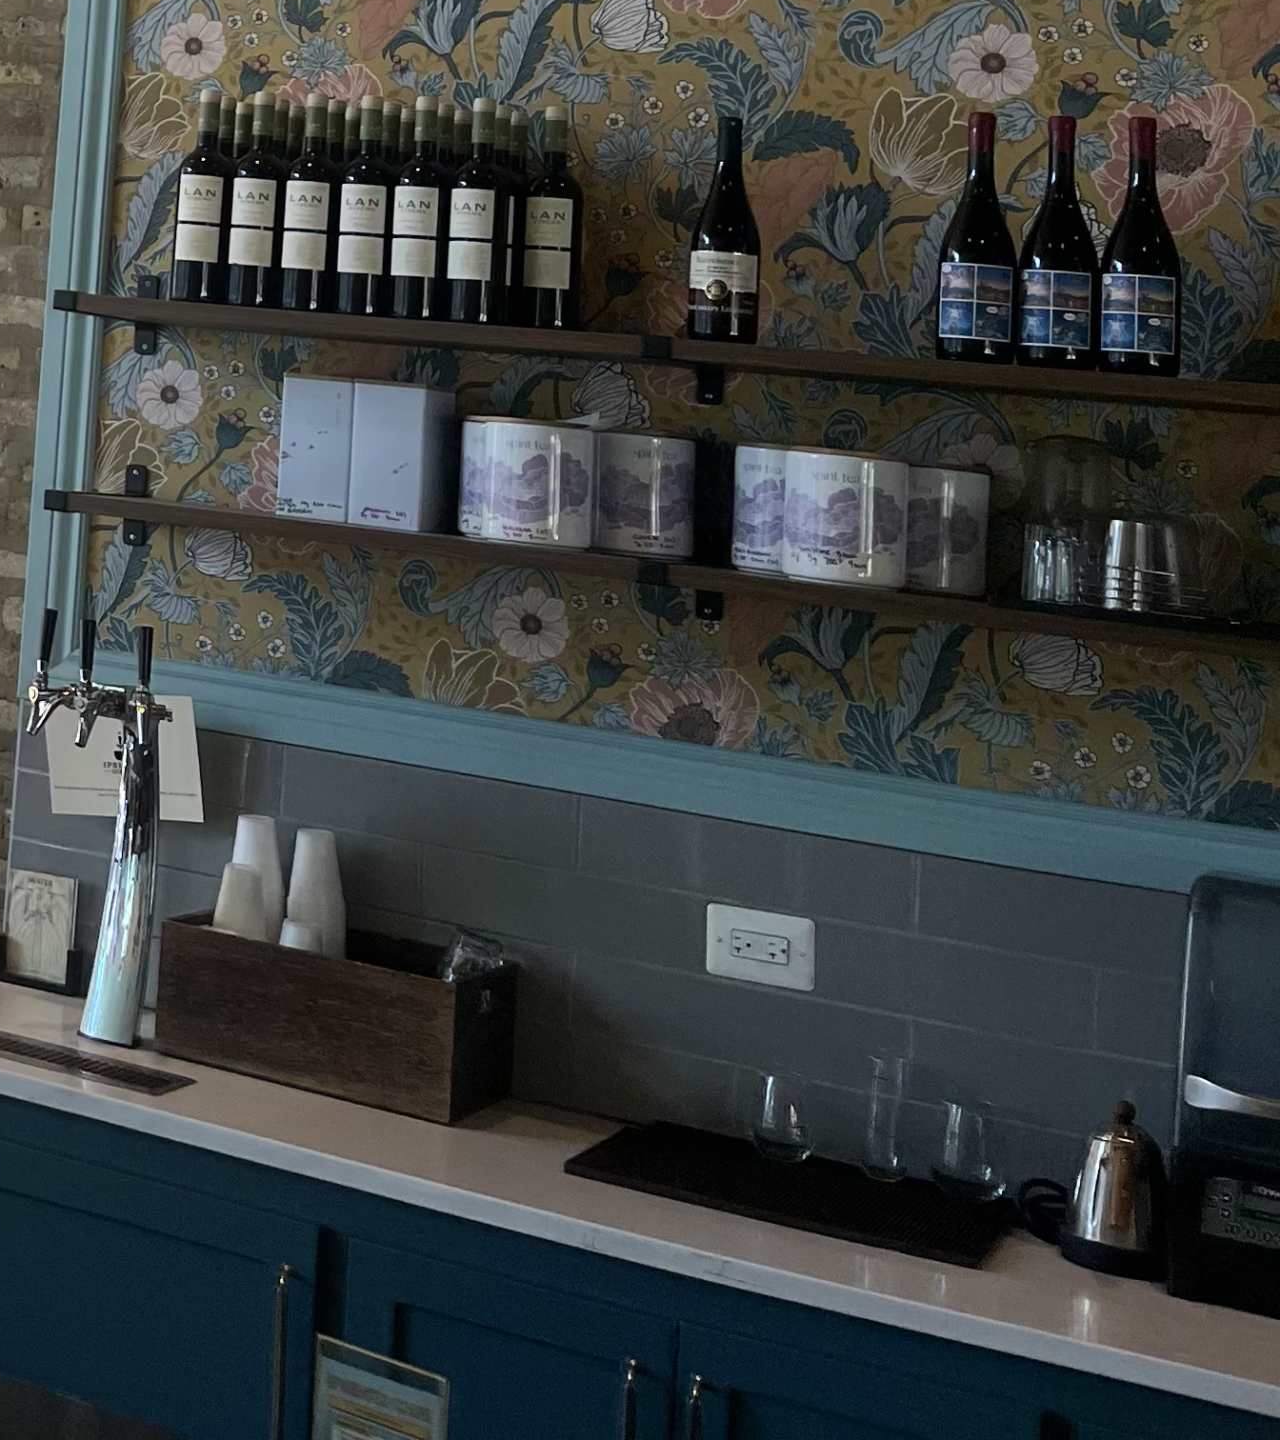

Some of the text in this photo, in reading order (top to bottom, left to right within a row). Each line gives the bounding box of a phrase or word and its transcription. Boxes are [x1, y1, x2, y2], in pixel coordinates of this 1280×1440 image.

[184, 187, 216, 198] LAN
[237, 191, 271, 201] LAN
[289, 194, 322, 204] LAN
[346, 196, 379, 207] LAN
[398, 199, 431, 209] LAN
[453, 201, 487, 212] LAN
[530, 210, 566, 221] LAN
